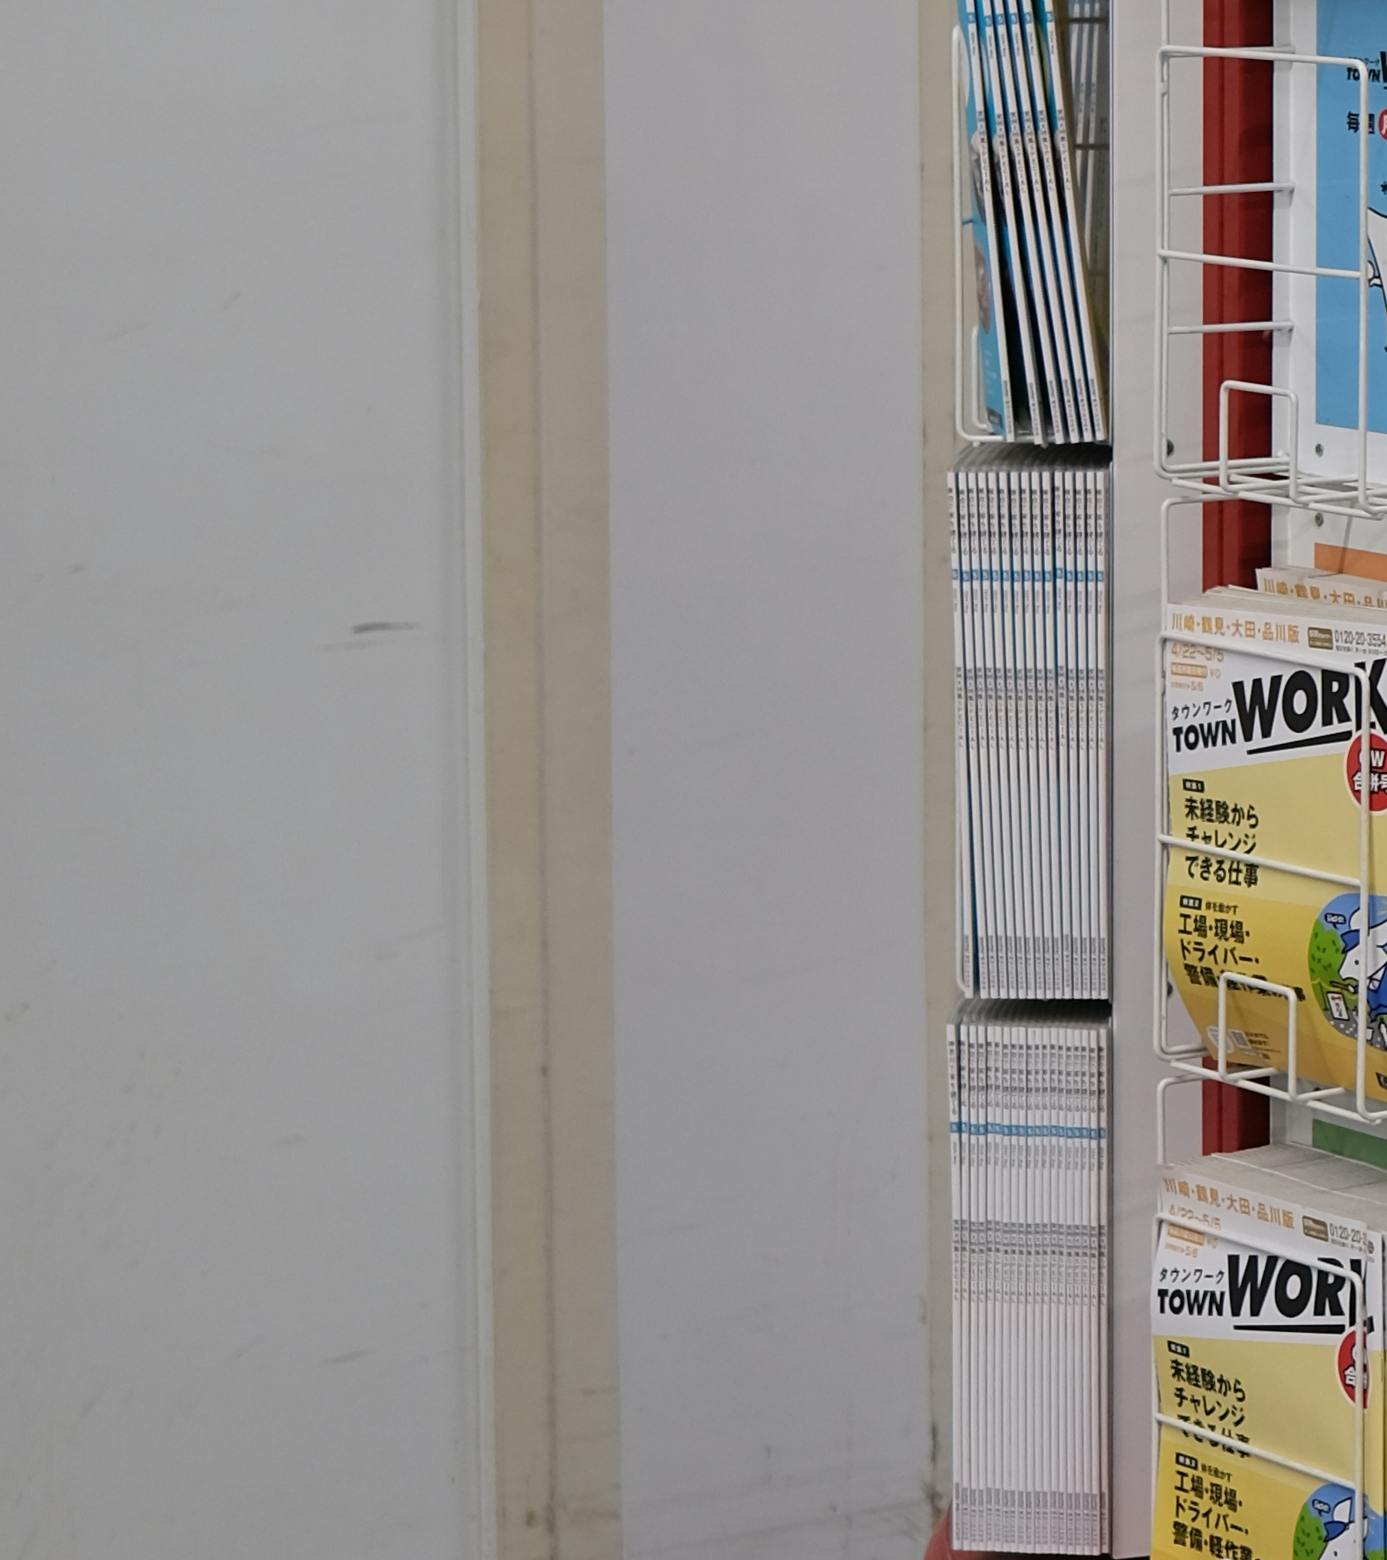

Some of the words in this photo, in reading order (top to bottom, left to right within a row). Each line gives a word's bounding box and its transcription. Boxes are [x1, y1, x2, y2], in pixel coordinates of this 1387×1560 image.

[1334, 629, 1387, 648] 0120-20-3554
[1171, 698, 1231, 721] タウンワーク
[1173, 719, 1236, 753] TOWN
[1184, 797, 1259, 828] 未経験から
[1185, 855, 1259, 887] できる仕事
[1159, 1268, 1224, 1283] タウンワーク
[1157, 1289, 1225, 1317] TOWN
[1169, 1359, 1246, 1403] 未経験から
[1174, 1387, 1245, 1426] チャレンジ
